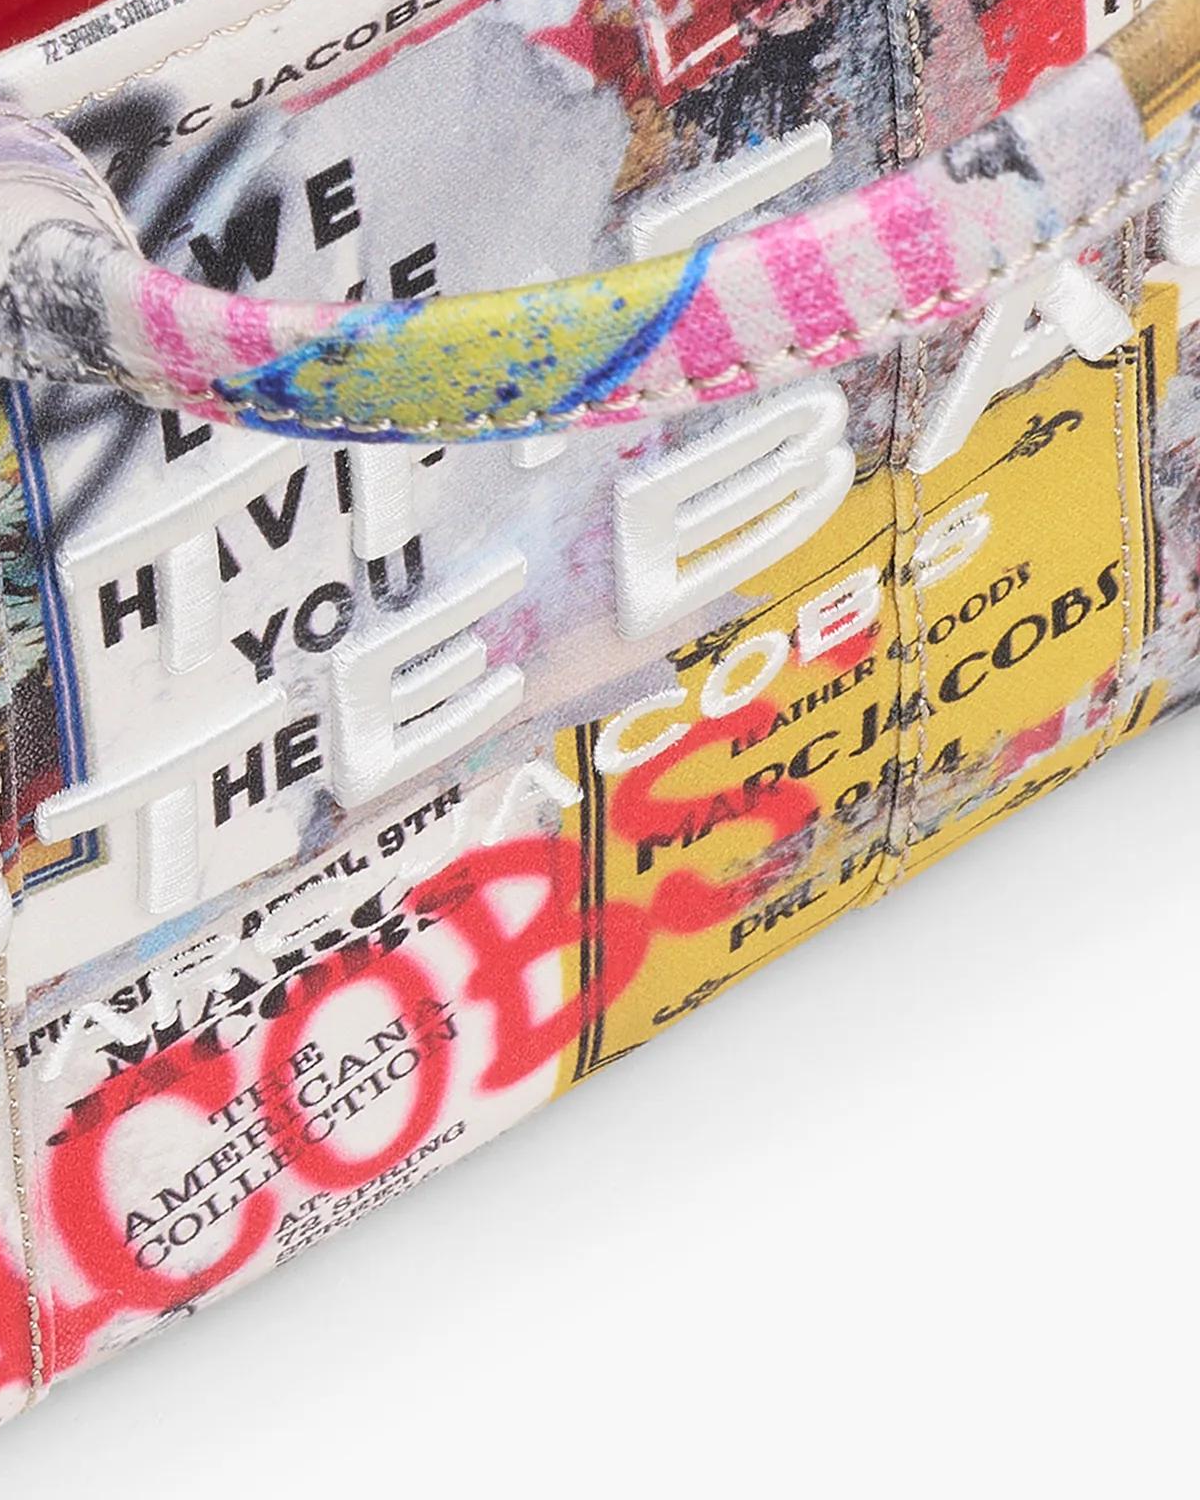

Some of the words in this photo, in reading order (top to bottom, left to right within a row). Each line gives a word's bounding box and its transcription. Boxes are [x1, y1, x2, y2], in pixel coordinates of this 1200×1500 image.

[59, 12, 119, 57] SPRING
[189, 157, 362, 294] WE
[231, 533, 424, 684] YOU
[730, 659, 876, 760] LEATHER
[887, 561, 1032, 665] GOODS
[398, 491, 992, 879] JACOBS
[635, 730, 841, 876] MARC
[849, 560, 1121, 757] JACOBS
[377, 783, 462, 858] 9TH
[123, 998, 453, 1246] AMERICANA
[132, 1011, 460, 1272] COLLECTION
[208, 1039, 326, 1133] THE
[277, 1214, 323, 1247] 72
[332, 1120, 467, 1217] SPRING
